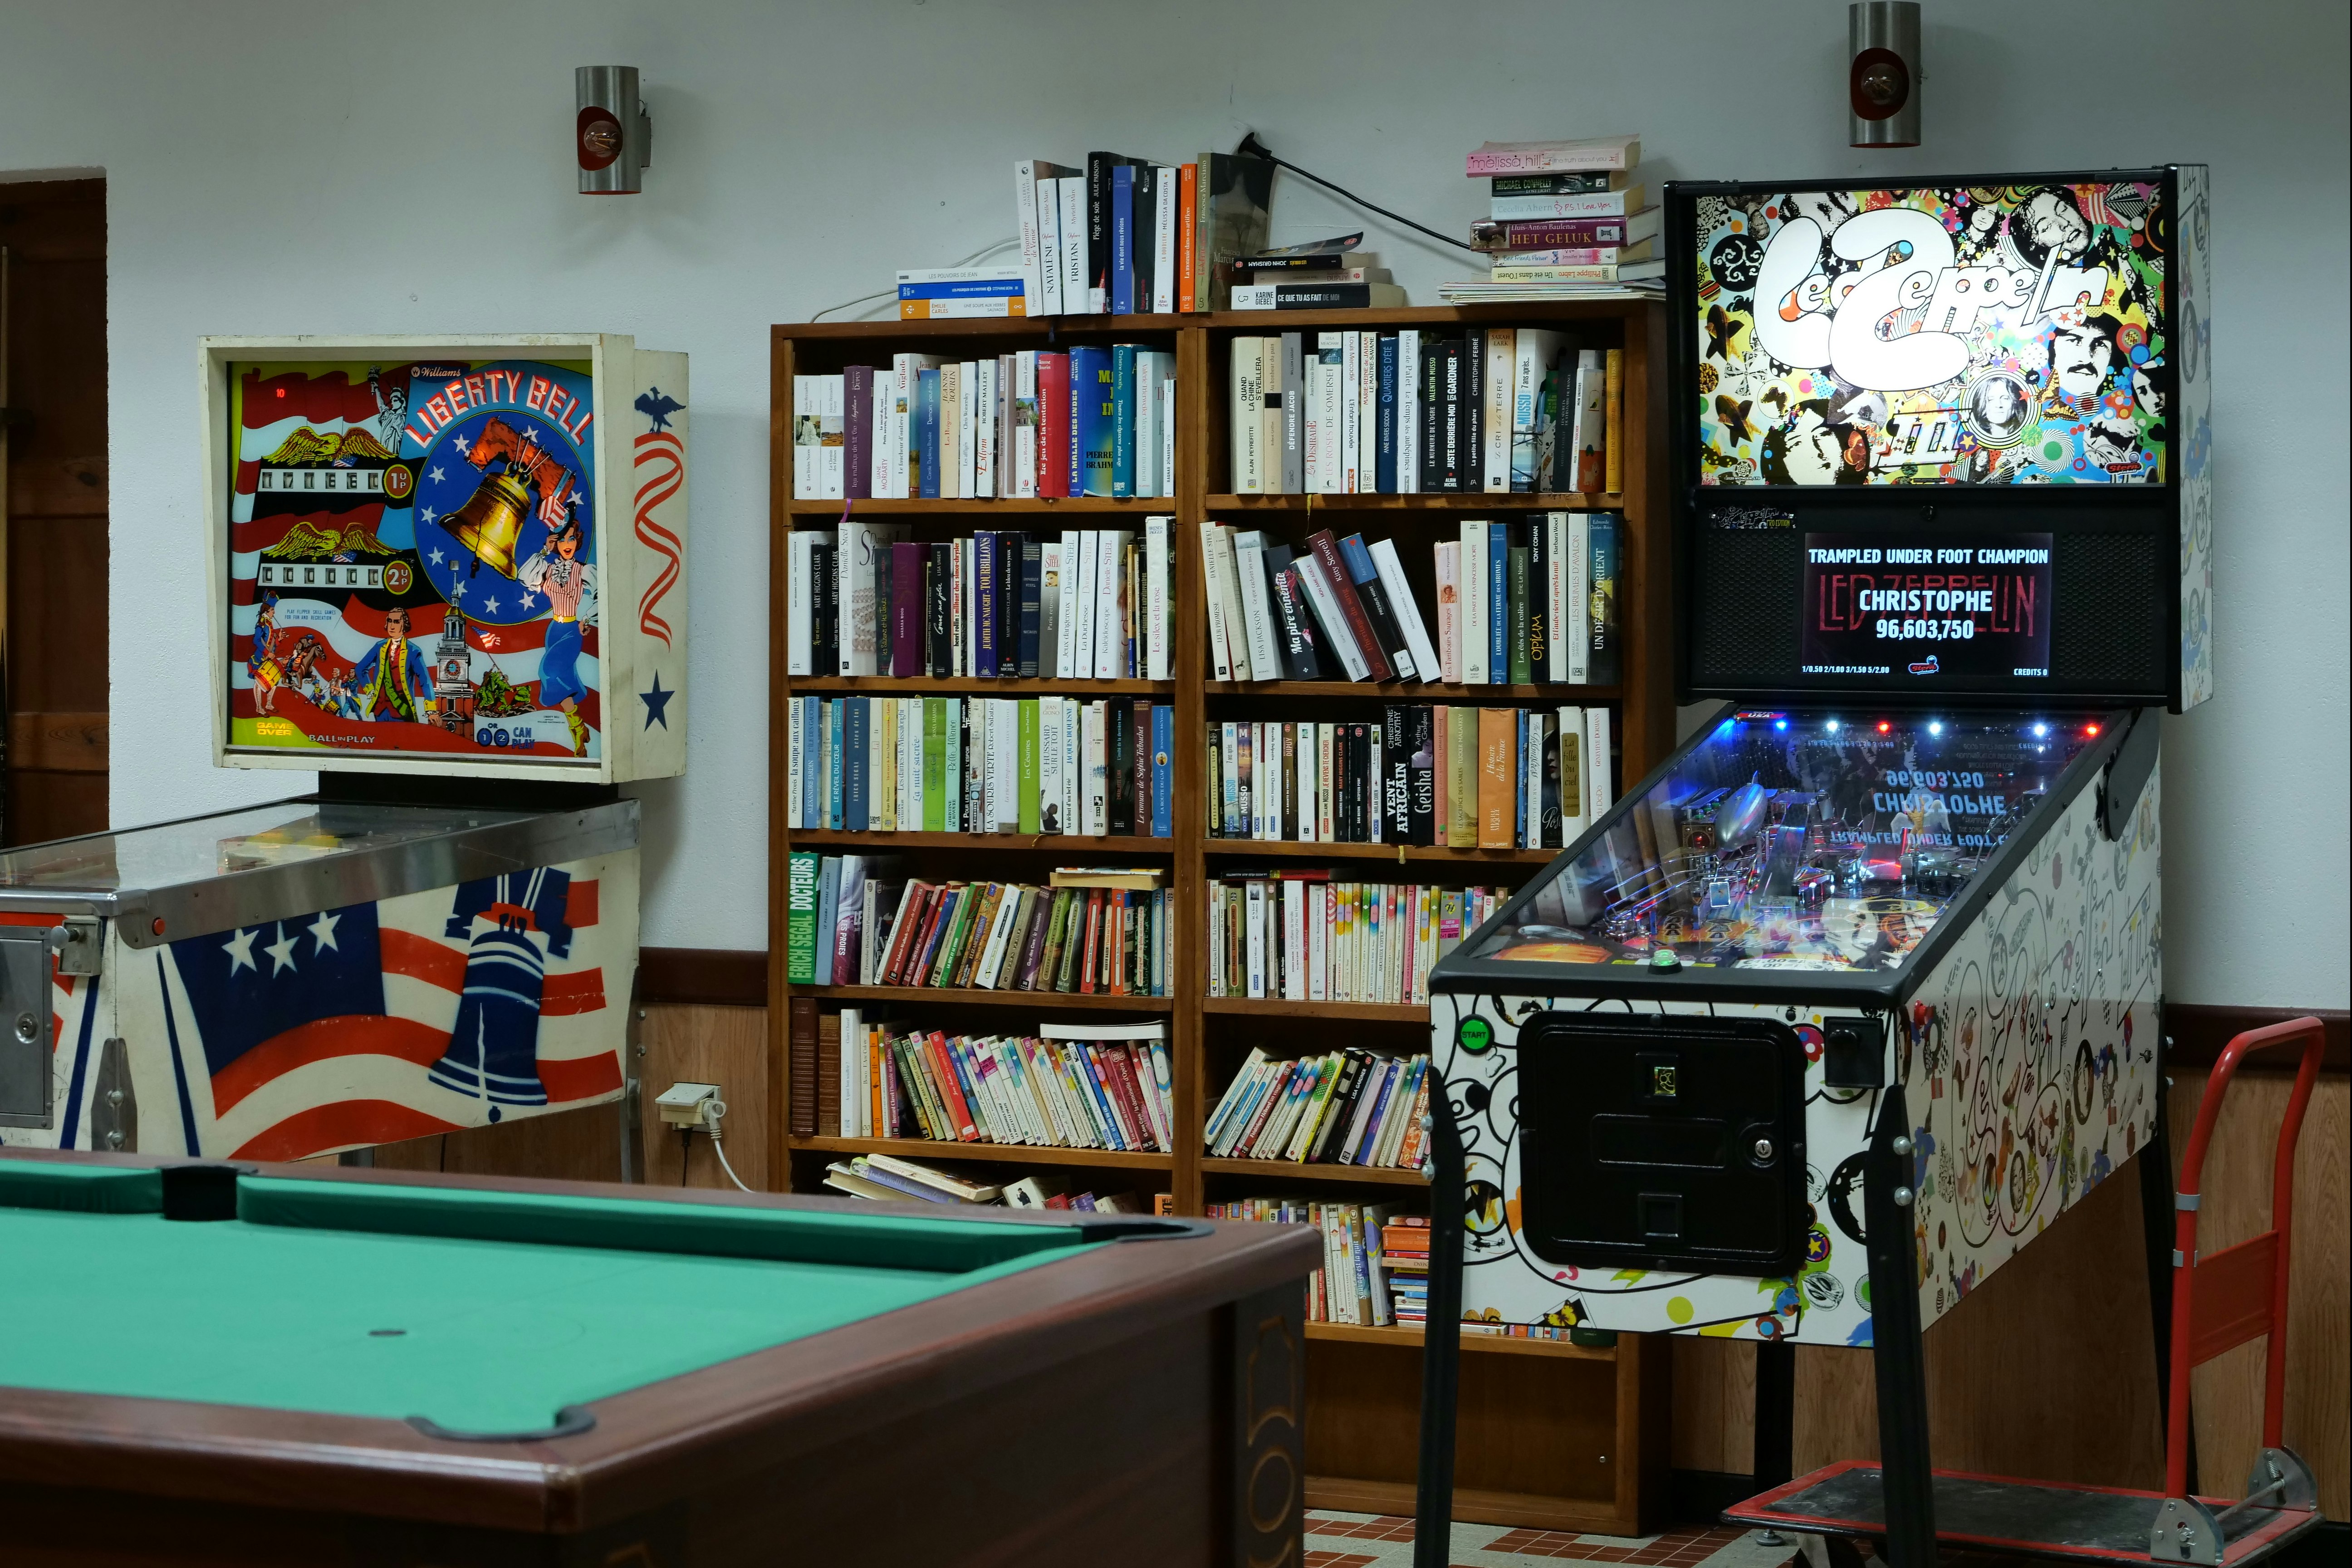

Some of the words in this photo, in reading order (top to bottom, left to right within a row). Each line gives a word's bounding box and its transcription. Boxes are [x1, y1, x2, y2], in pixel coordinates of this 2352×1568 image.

[1471, 155, 1521, 170] melissa
[1525, 154, 1541, 167] hill
[1496, 180, 1521, 190] MICHAEL
[1524, 178, 1552, 189] CONNELLY
[1511, 234, 1540, 245] HET
[1545, 233, 1592, 244] GELUK
[1044, 243, 1054, 293] NATALÈNE
[1071, 242, 1079, 284] TRISTAN
[1382, 347, 1392, 363] D'ÉTÉ
[421, 367, 461, 377] Williams
[1382, 365, 1393, 402] QUARTIERS
[276, 388, 285, 398] 10
[404, 370, 524, 449] LIBERTY
[526, 375, 593, 446] BELL
[1249, 402, 1254, 411] LA
[1517, 394, 1531, 425] MUSSO
[1287, 414, 1295, 450] DÉFENDRE
[1072, 470, 1078, 483] LA
[980, 538, 990, 590] TOURBILLONS
[1317, 539, 1335, 566] Sewell
[1808, 549, 1881, 564] TRAMPLED
[1886, 549, 1932, 563] UNDER
[1937, 549, 1973, 563] FOOT
[1978, 549, 2048, 564] CHAMPION
[1329, 566, 1343, 582] Kitty
[1594, 549, 1605, 597] D'ORIENT
[1860, 590, 1992, 611] CHRISTOPHE
[1286, 616, 1302, 635] pire
[1593, 602, 1604, 632] DÉSIR
[1876, 619, 1974, 640] 96,603,750
[1291, 637, 1303, 654] Ma
[1594, 635, 1604, 650] UN
[512, 739, 535, 749] PLAY
[513, 727, 532, 738] CAN
[987, 751, 995, 780] VERTE
[1387, 779, 1395, 816] VENT
[1395, 763, 1408, 833] AFRICAIN
[1414, 770, 1432, 813] Geisha
[987, 819, 994, 830] LA
[790, 858, 814, 910] DOCTEURS
[790, 915, 813, 946] SEGAL
[789, 949, 812, 978] ERICH
[1461, 1030, 1486, 1039] START
[1350, 1085, 1358, 1099] LISA
[1355, 1068, 1367, 1086] GARDNER
[1355, 1273, 1366, 1299] Sauvage
